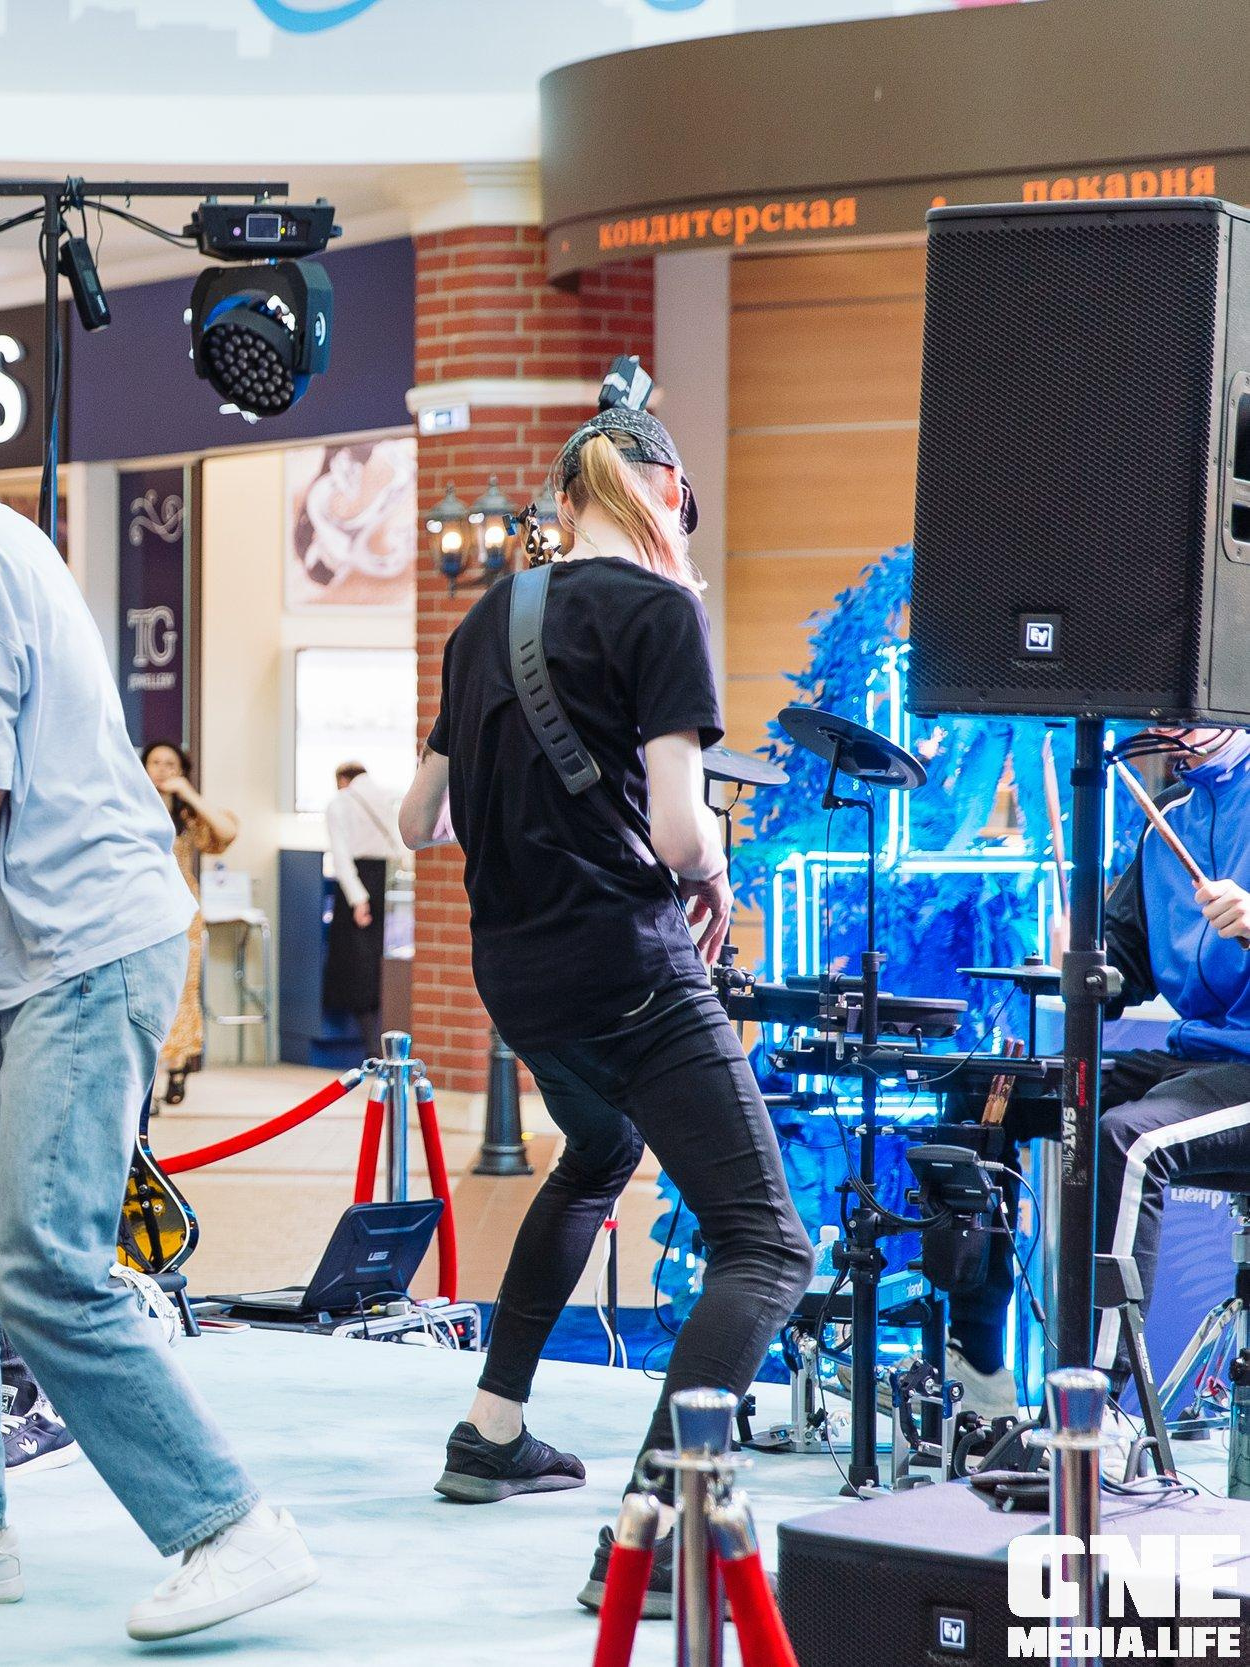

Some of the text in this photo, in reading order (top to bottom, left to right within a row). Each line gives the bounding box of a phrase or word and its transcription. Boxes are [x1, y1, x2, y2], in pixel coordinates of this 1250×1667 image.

[1022, 165, 1215, 203] пекарня
[598, 197, 857, 248] кондитерская
[1171, 1187, 1223, 1210] центр
